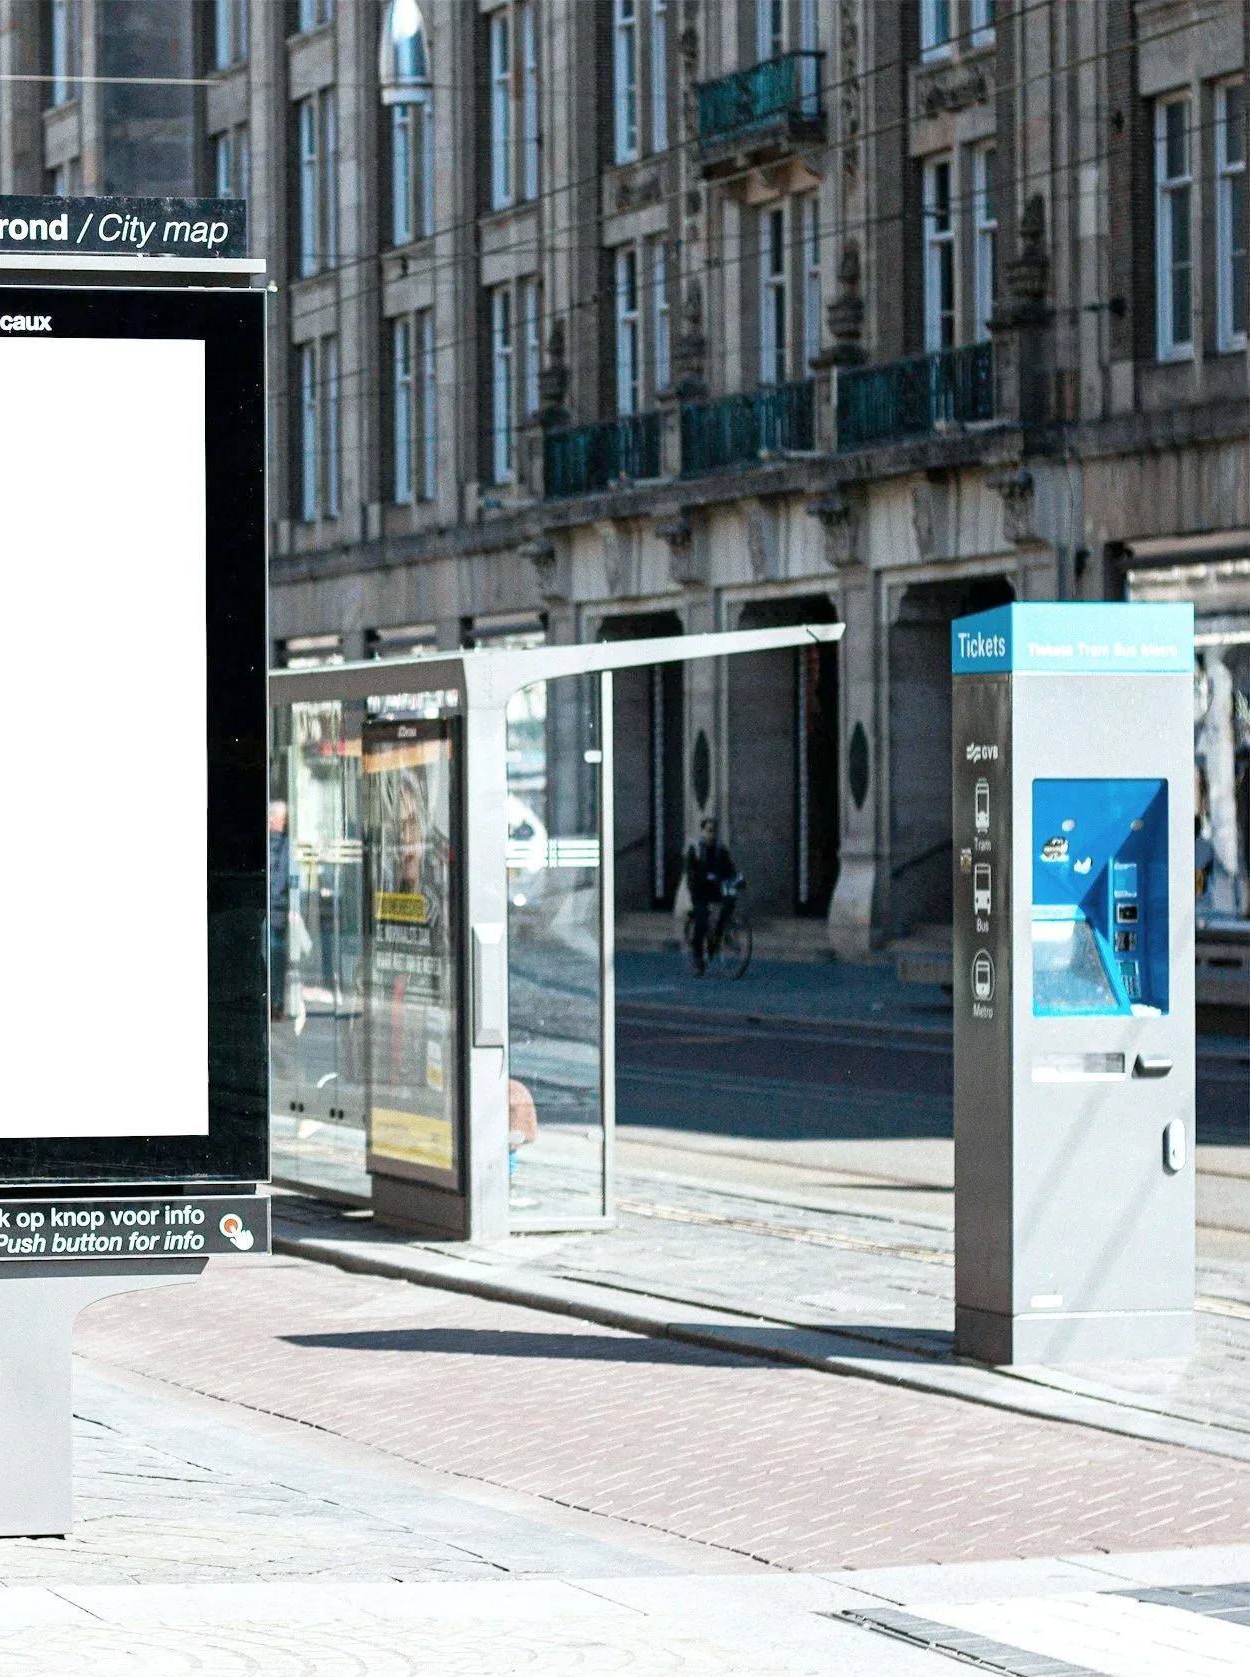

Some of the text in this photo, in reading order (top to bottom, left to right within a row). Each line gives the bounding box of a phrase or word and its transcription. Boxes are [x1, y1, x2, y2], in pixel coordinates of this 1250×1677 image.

[98, 214, 157, 249] City
[163, 221, 229, 249] map
[958, 632, 1006, 659] Tickets
[1028, 642, 1179, 658] Tickets Tram Bus Metro
[981, 745, 999, 760] GVB
[974, 837, 992, 852] Tram
[976, 917, 990, 932] Bus
[972, 1003, 994, 1019] Metro
[16, 1212, 45, 1231] op
[51, 1206, 105, 1231] knop
[109, 1209, 160, 1227] voor
[164, 1205, 206, 1226] info
[52, 1232, 125, 1254] button
[128, 1231, 160, 1252] for
[162, 1231, 205, 1251] info
